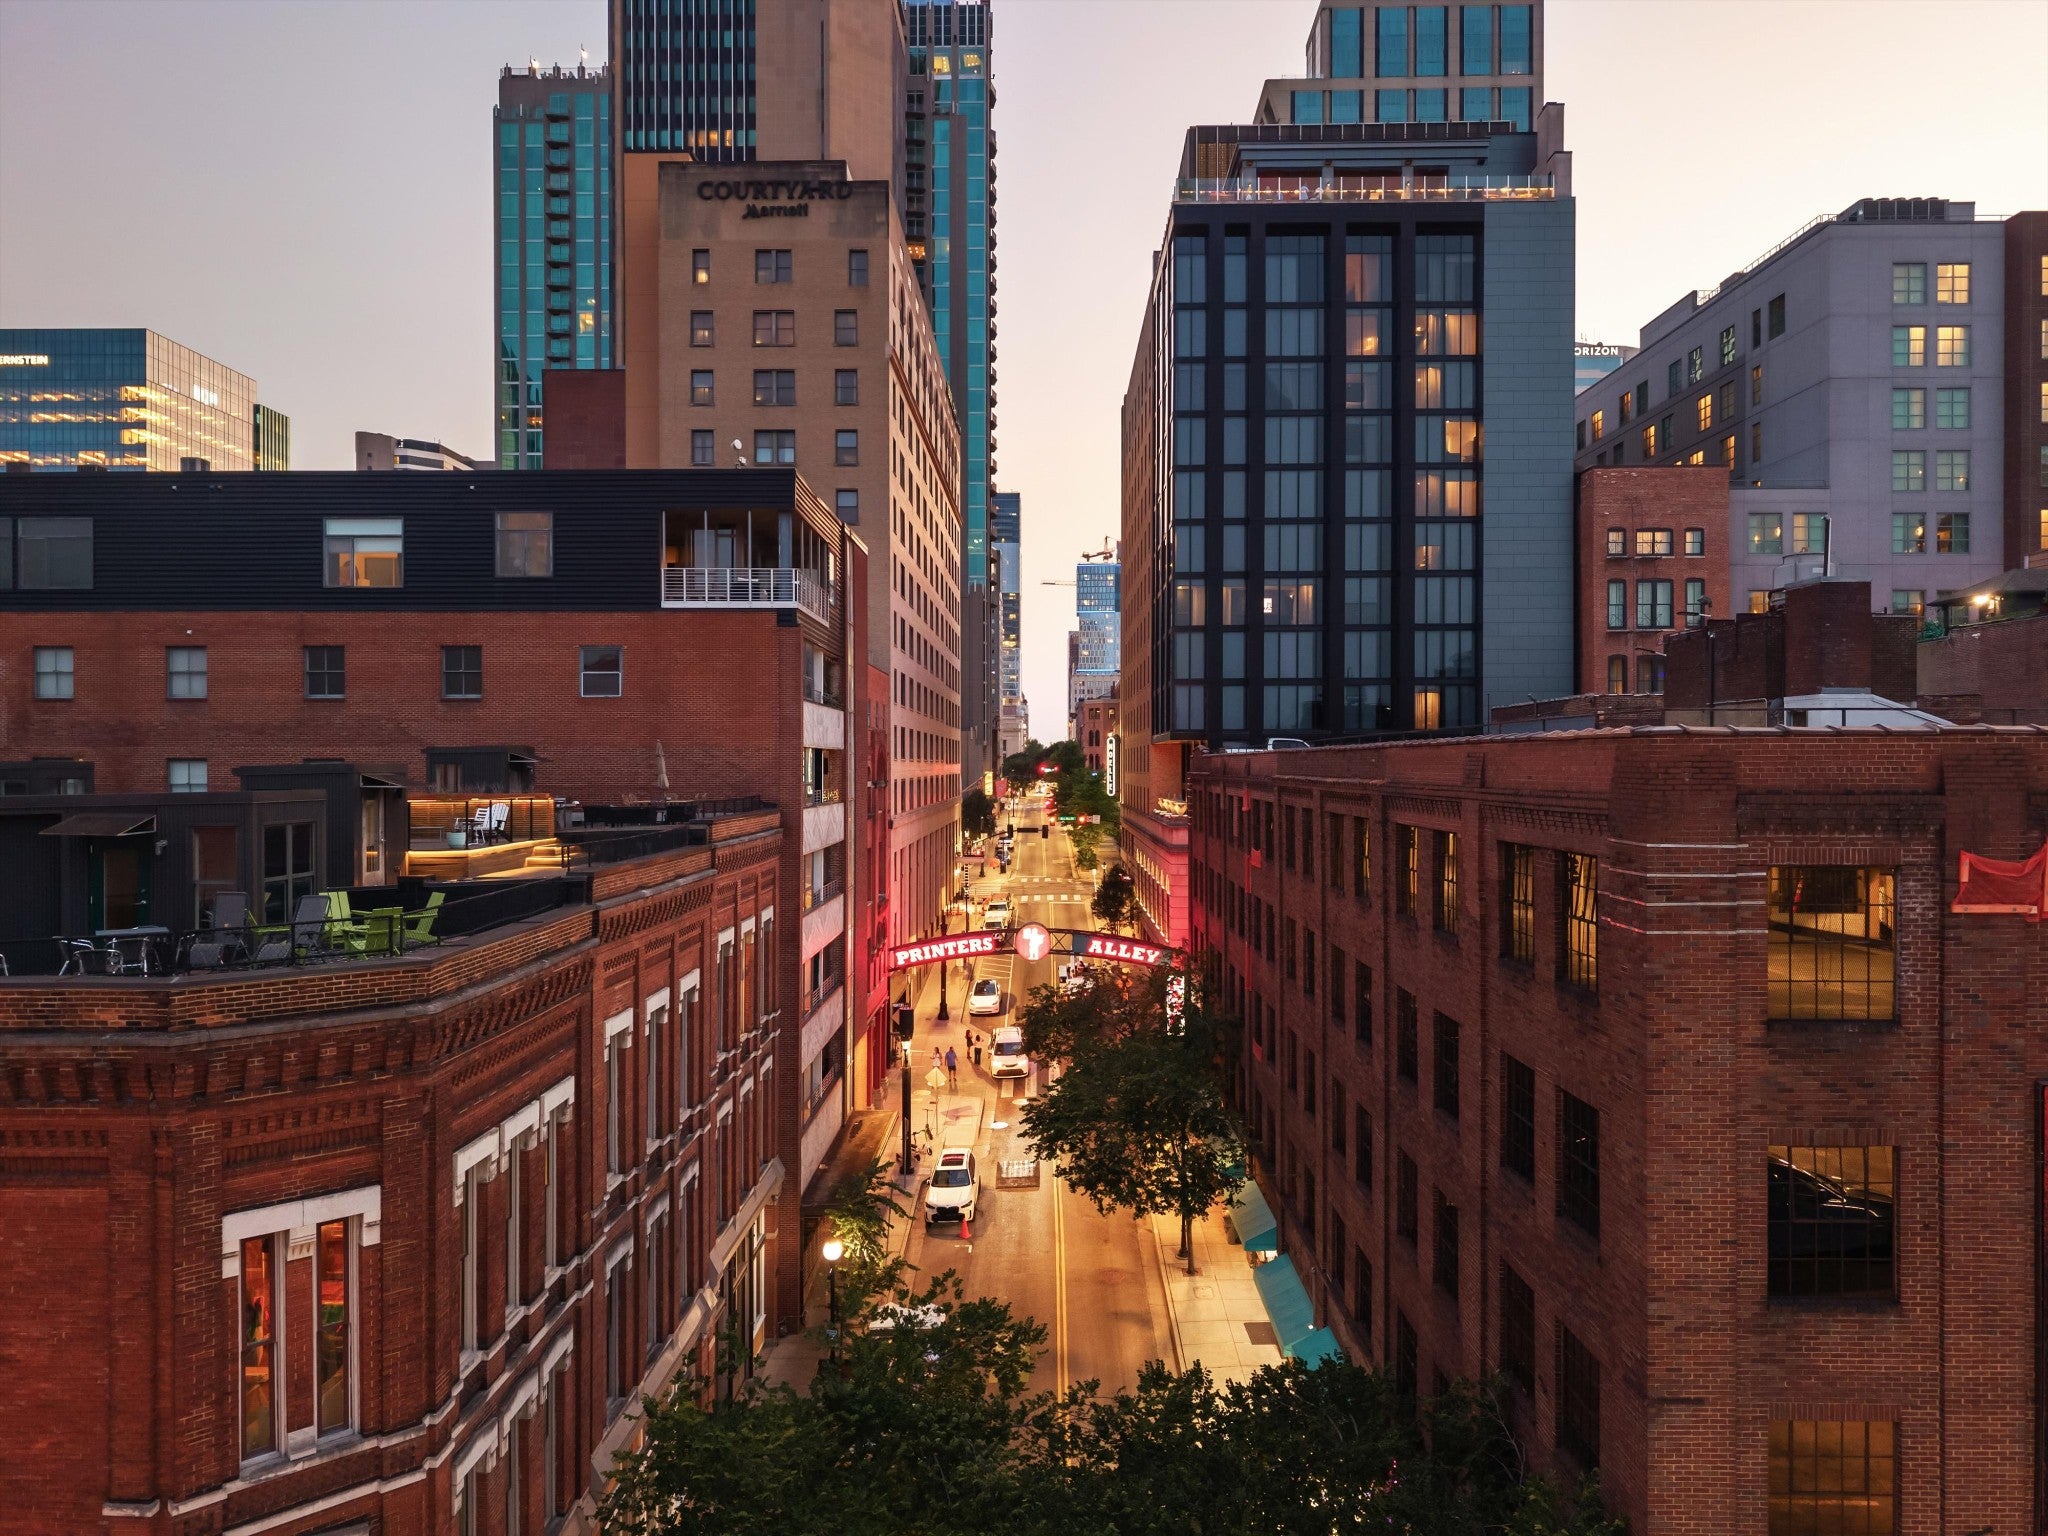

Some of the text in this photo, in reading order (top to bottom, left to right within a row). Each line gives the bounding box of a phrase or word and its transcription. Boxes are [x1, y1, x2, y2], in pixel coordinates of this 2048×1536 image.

[697, 180, 853, 201] COURTYARD
[742, 203, 809, 220] Marriott
[895, 937, 1160, 966] PRINTERS ALLEY
